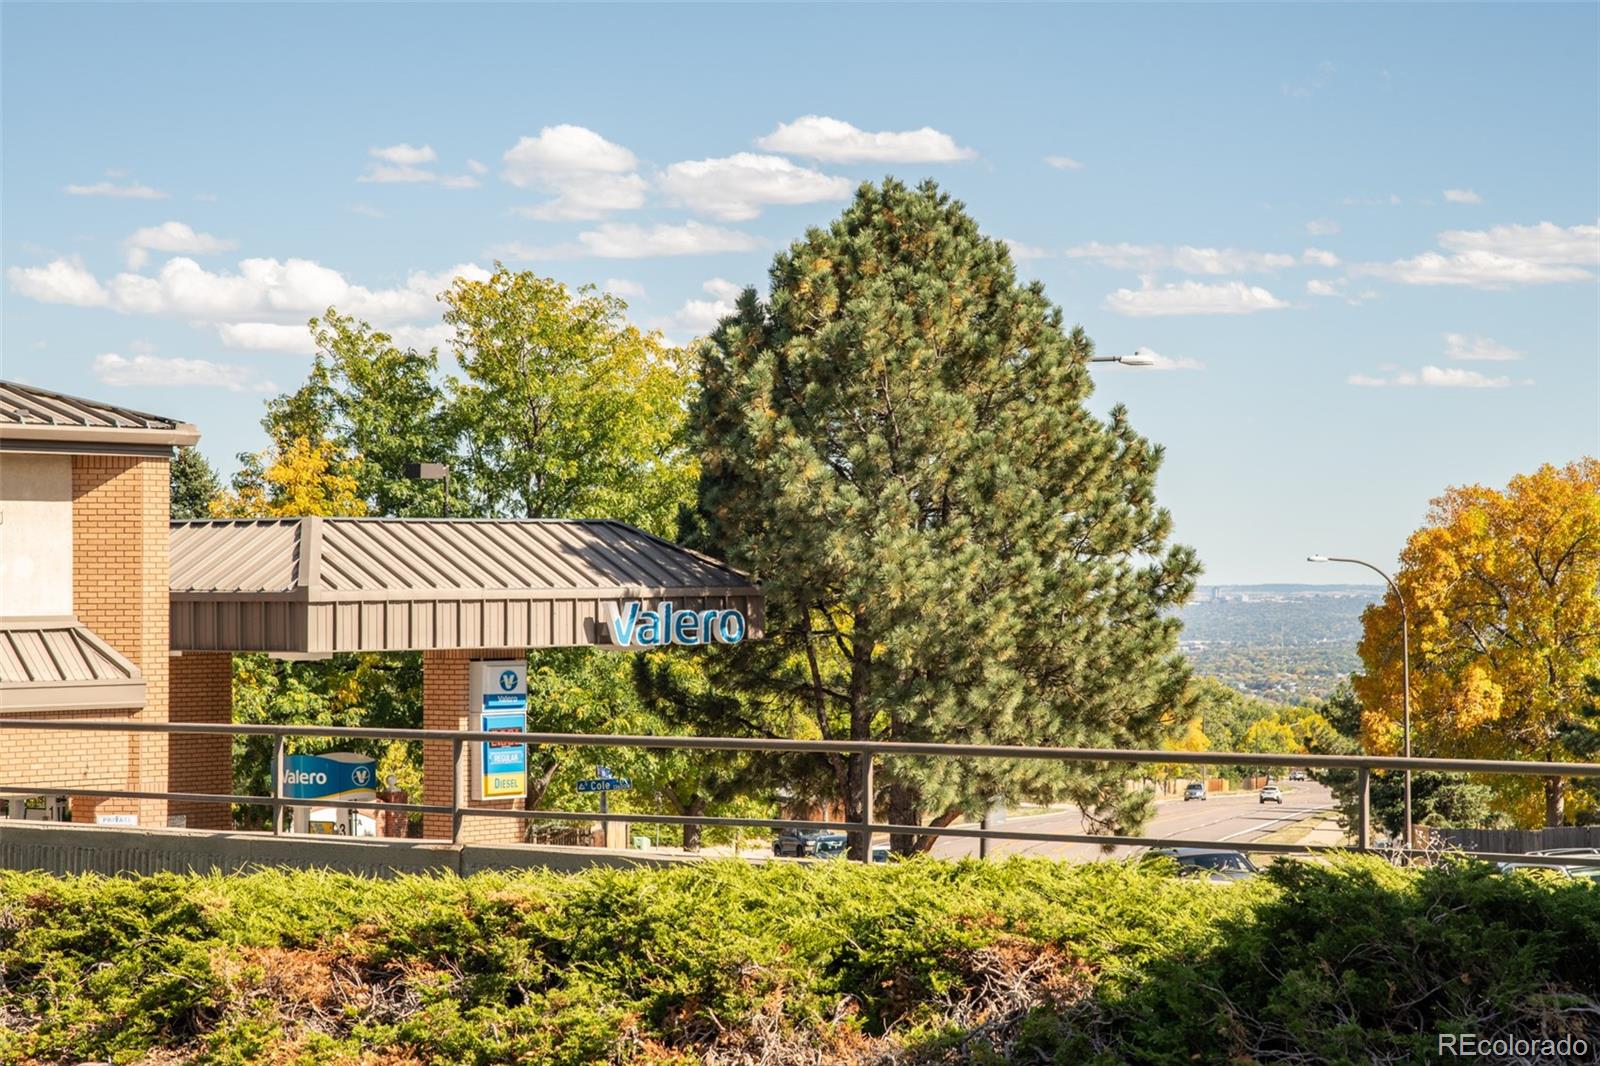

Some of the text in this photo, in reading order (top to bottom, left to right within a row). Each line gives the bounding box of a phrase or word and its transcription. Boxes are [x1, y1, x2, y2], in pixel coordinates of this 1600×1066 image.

[605, 601, 746, 646] Valero
[497, 695, 518, 703] Valero
[494, 778, 518, 789] DIESEL
[590, 781, 610, 791] Cole
